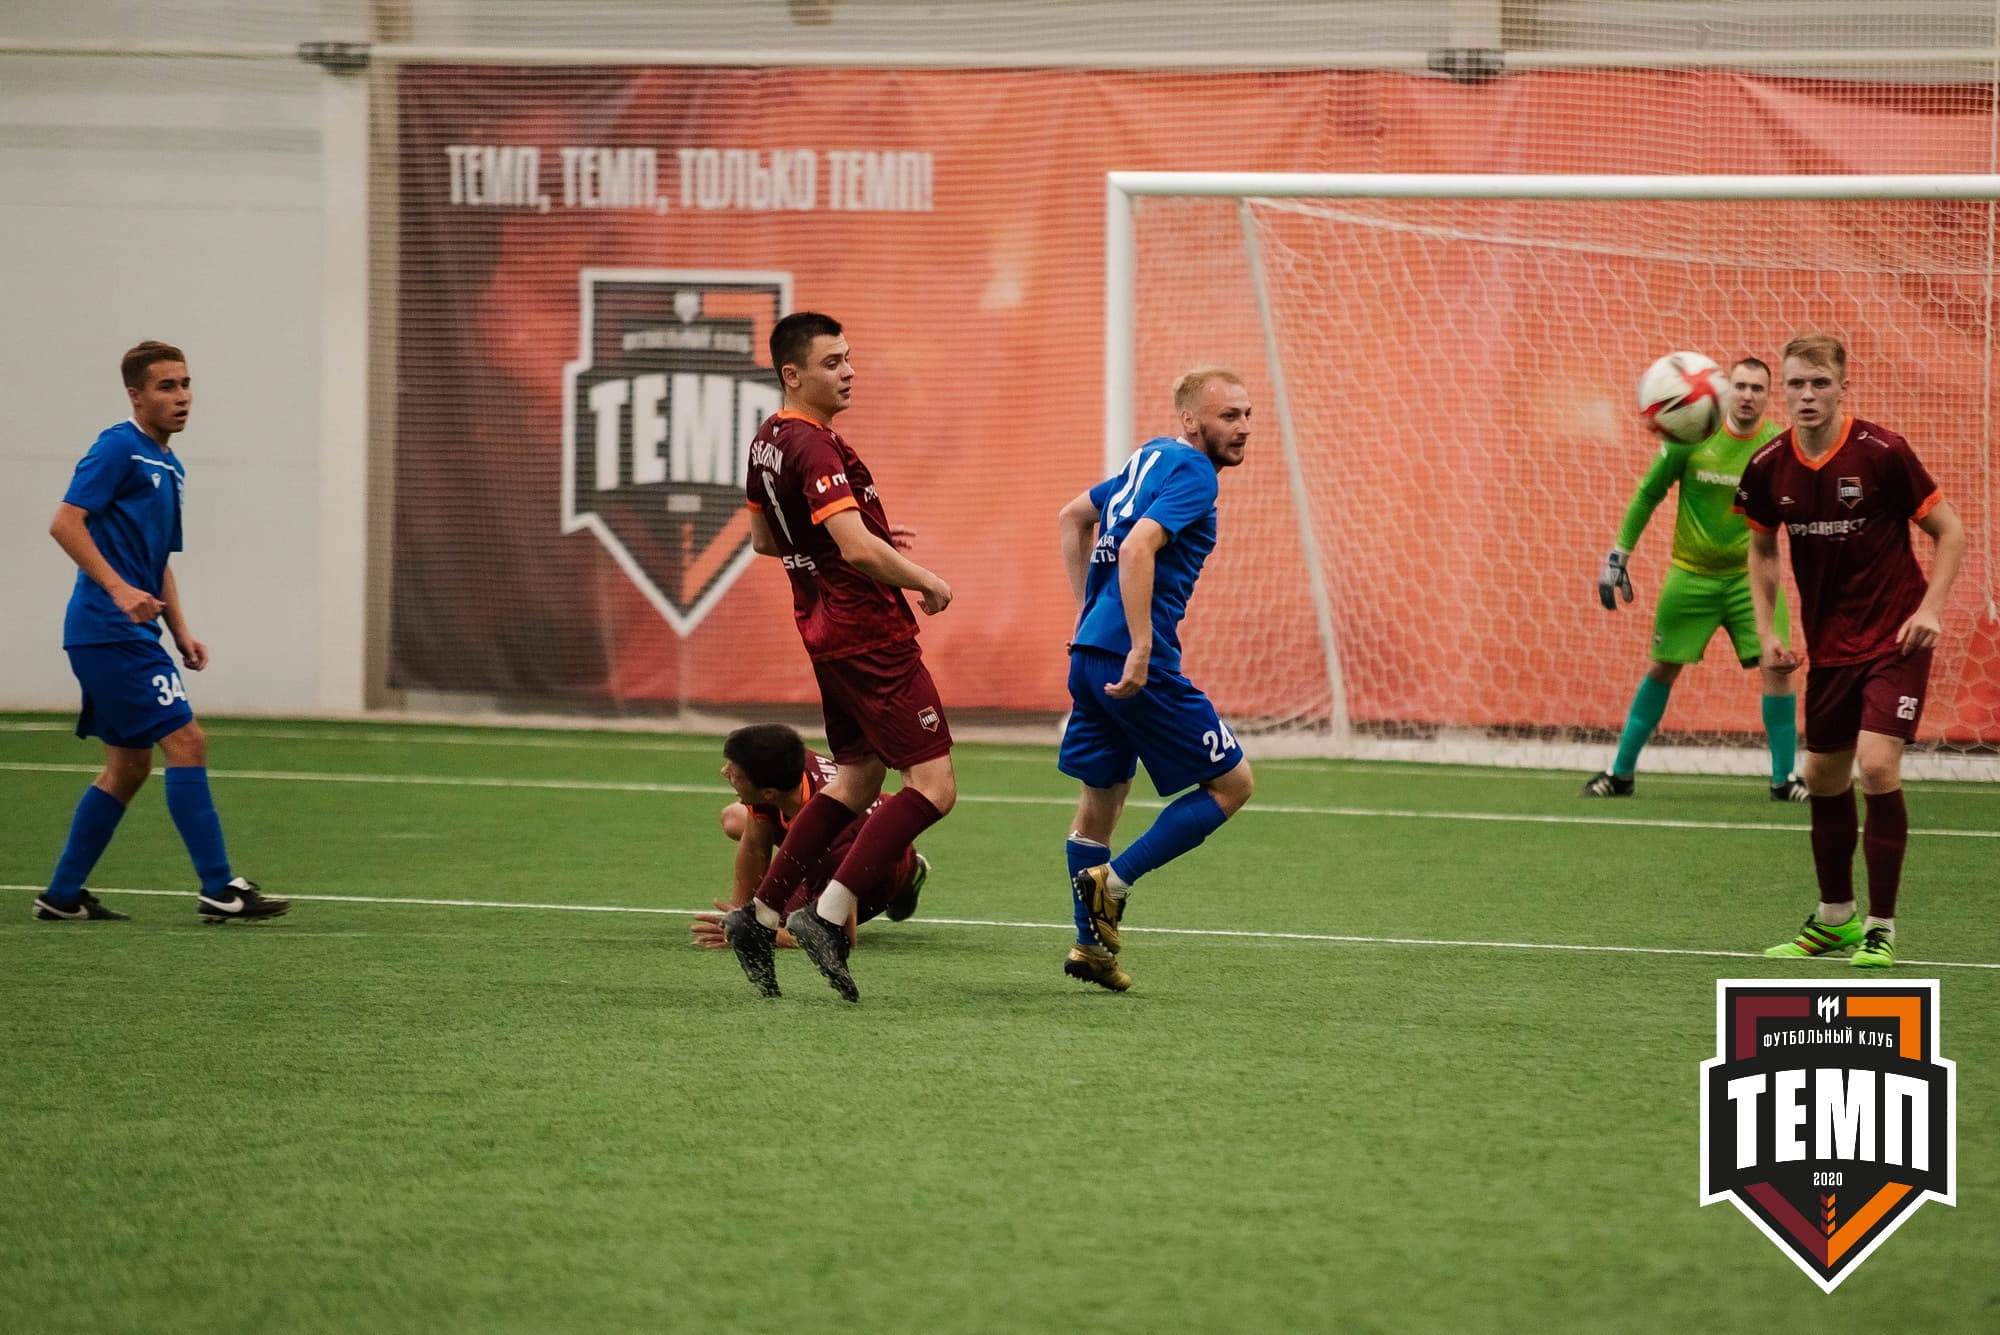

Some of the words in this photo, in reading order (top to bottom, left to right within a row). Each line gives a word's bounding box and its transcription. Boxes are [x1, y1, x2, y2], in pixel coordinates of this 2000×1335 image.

[446, 145, 551, 214] ТЕМП,
[559, 146, 668, 214] ТЕМП,
[677, 148, 817, 211] ТОЛЬКО
[827, 150, 933, 212] ТЕМП!
[152, 672, 186, 706] 34
[1202, 719, 1237, 763] 24
